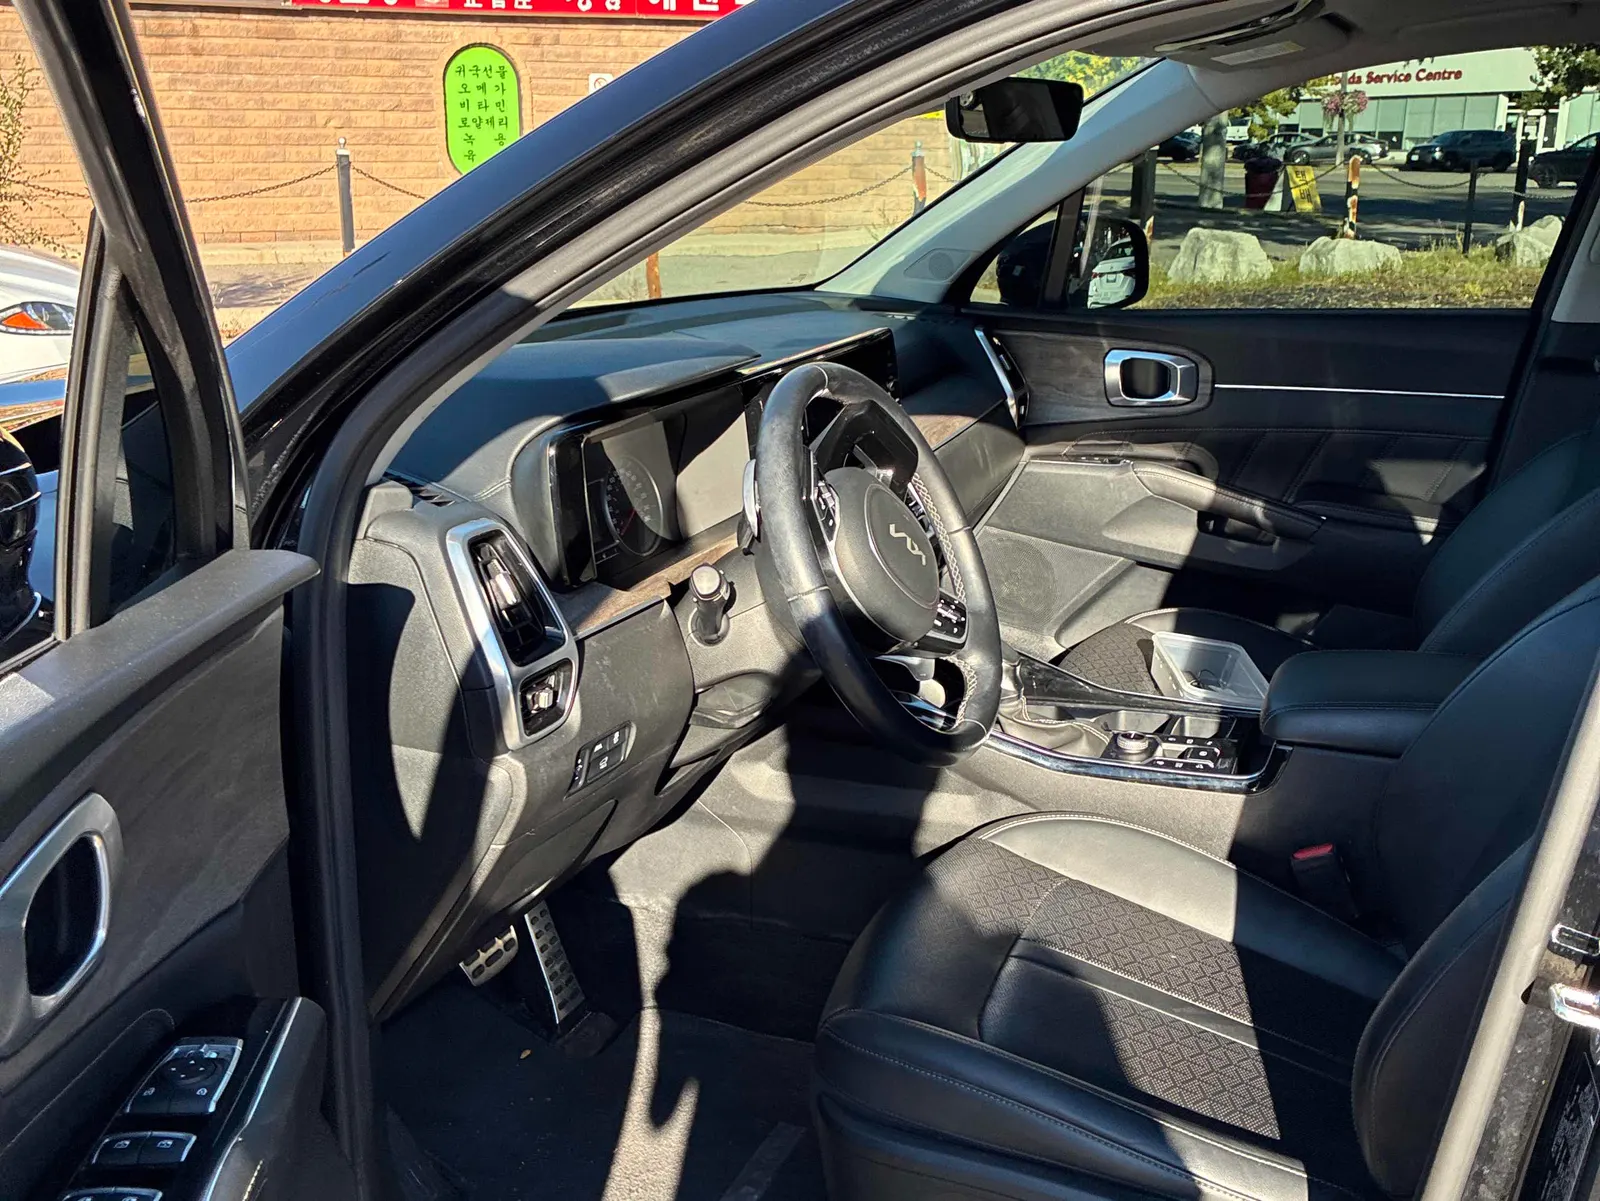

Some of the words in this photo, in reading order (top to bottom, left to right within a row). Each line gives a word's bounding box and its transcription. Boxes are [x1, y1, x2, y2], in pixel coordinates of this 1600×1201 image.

[455, 64, 507, 79] 귀국선물
[1366, 69, 1411, 84] Service
[1416, 68, 1462, 82] Centre
[458, 115, 508, 129] 로얄제리
